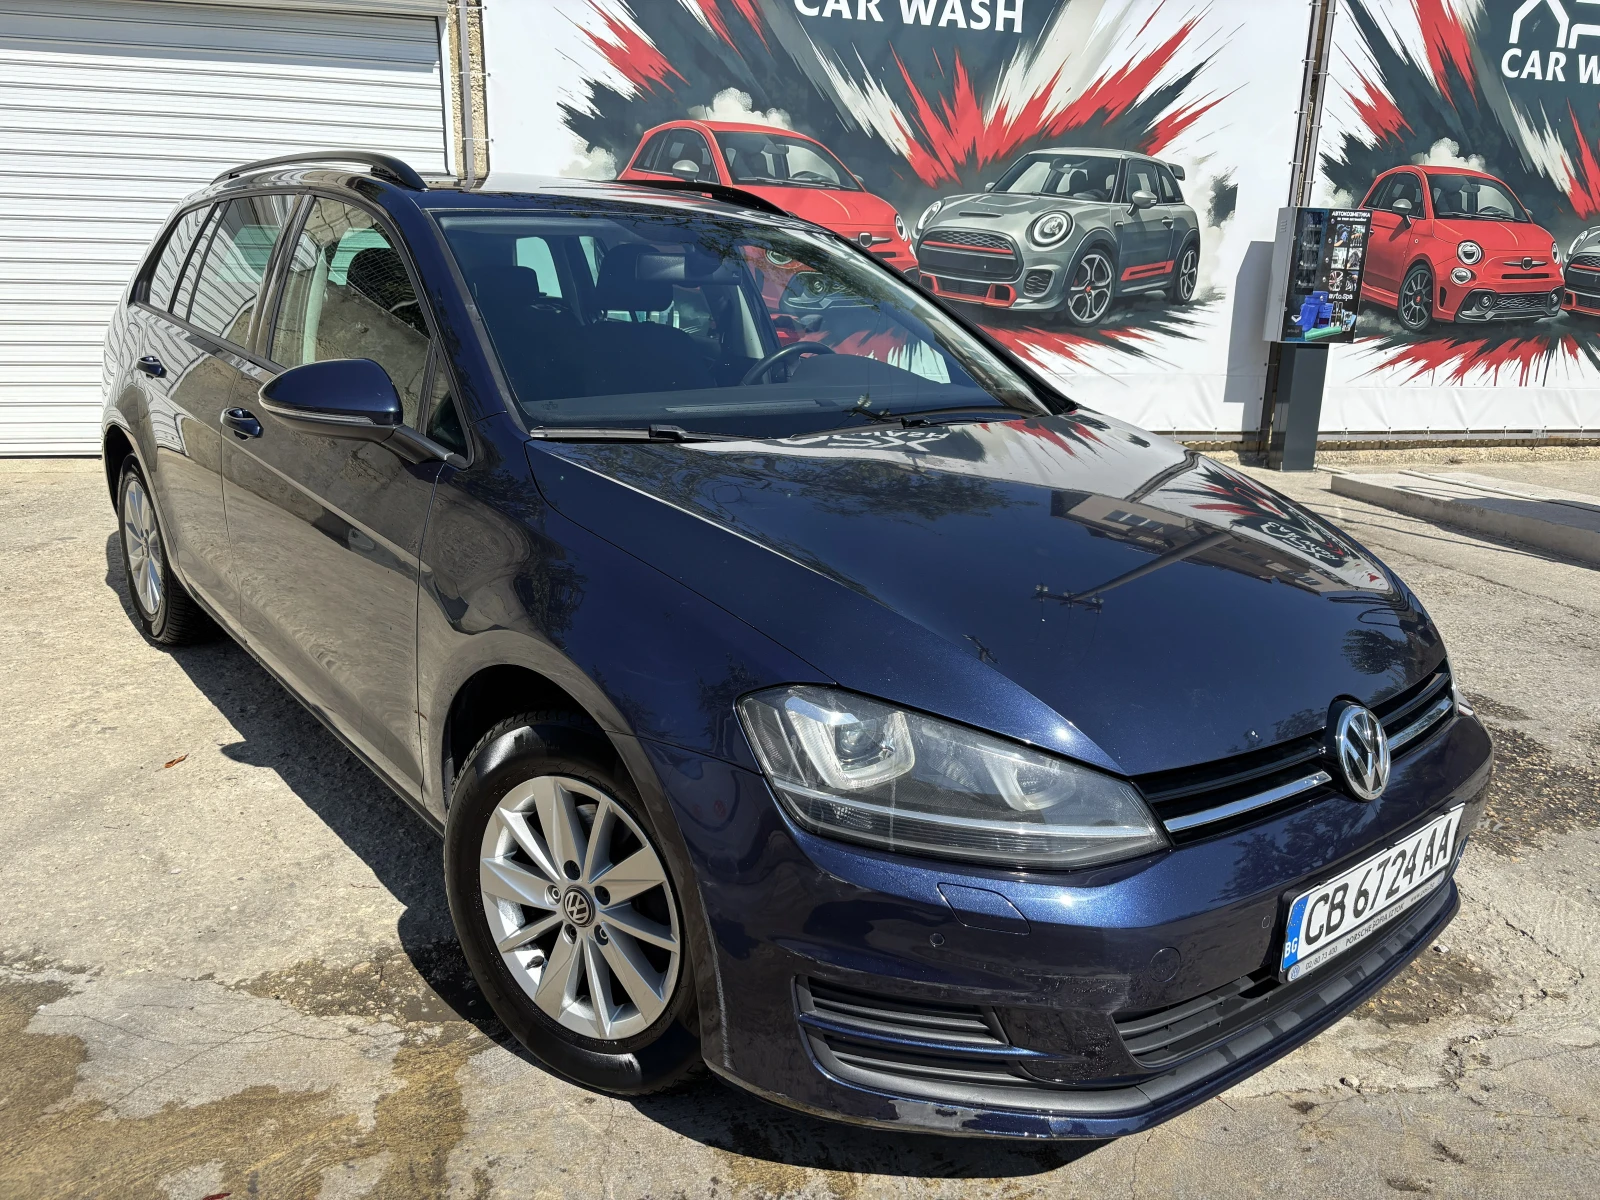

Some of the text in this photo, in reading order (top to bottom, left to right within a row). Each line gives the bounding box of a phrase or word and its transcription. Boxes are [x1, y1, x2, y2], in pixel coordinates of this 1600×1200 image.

[899, 0, 1024, 33] WASH
[1501, 47, 1600, 85] CAR W
[1352, 837, 1422, 919] 6724
[1420, 818, 1453, 876] AA
[1284, 937, 1299, 958] BG
[1345, 923, 1373, 947] PORSCHE
